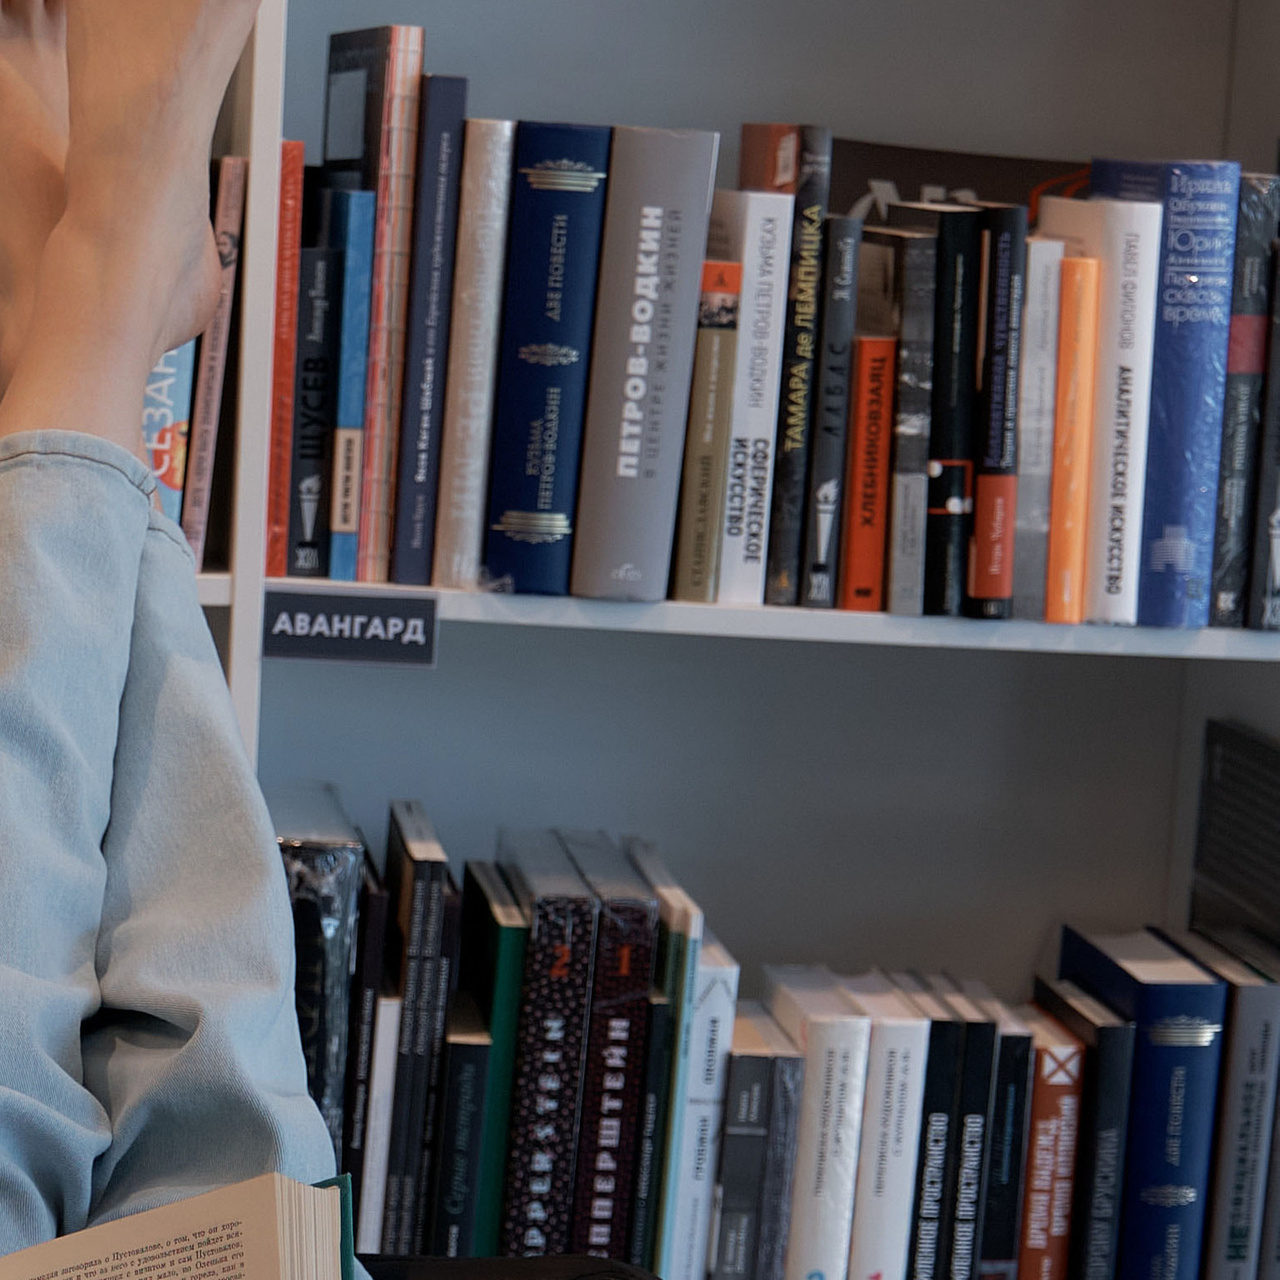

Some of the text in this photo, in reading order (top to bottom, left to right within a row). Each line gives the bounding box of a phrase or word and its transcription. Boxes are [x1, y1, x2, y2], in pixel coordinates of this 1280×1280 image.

[794, 204, 824, 329] ЛЕМПИЦКА
[615, 205, 664, 479] ПЕТРОВ-ВОДКИН
[301, 356, 329, 461] ЩУСЕВ
[782, 361, 811, 453] ТАМАРА
[1110, 365, 1133, 499] АНАЛИТИЧЕСКОЕ
[726, 438, 749, 538] ИСКУССТВО
[744, 439, 771, 564] СФЕРИЧЕСКОЕ
[1105, 506, 1127, 595] ИСКУССТВО
[272, 611, 426, 645] АВАНГАРД
